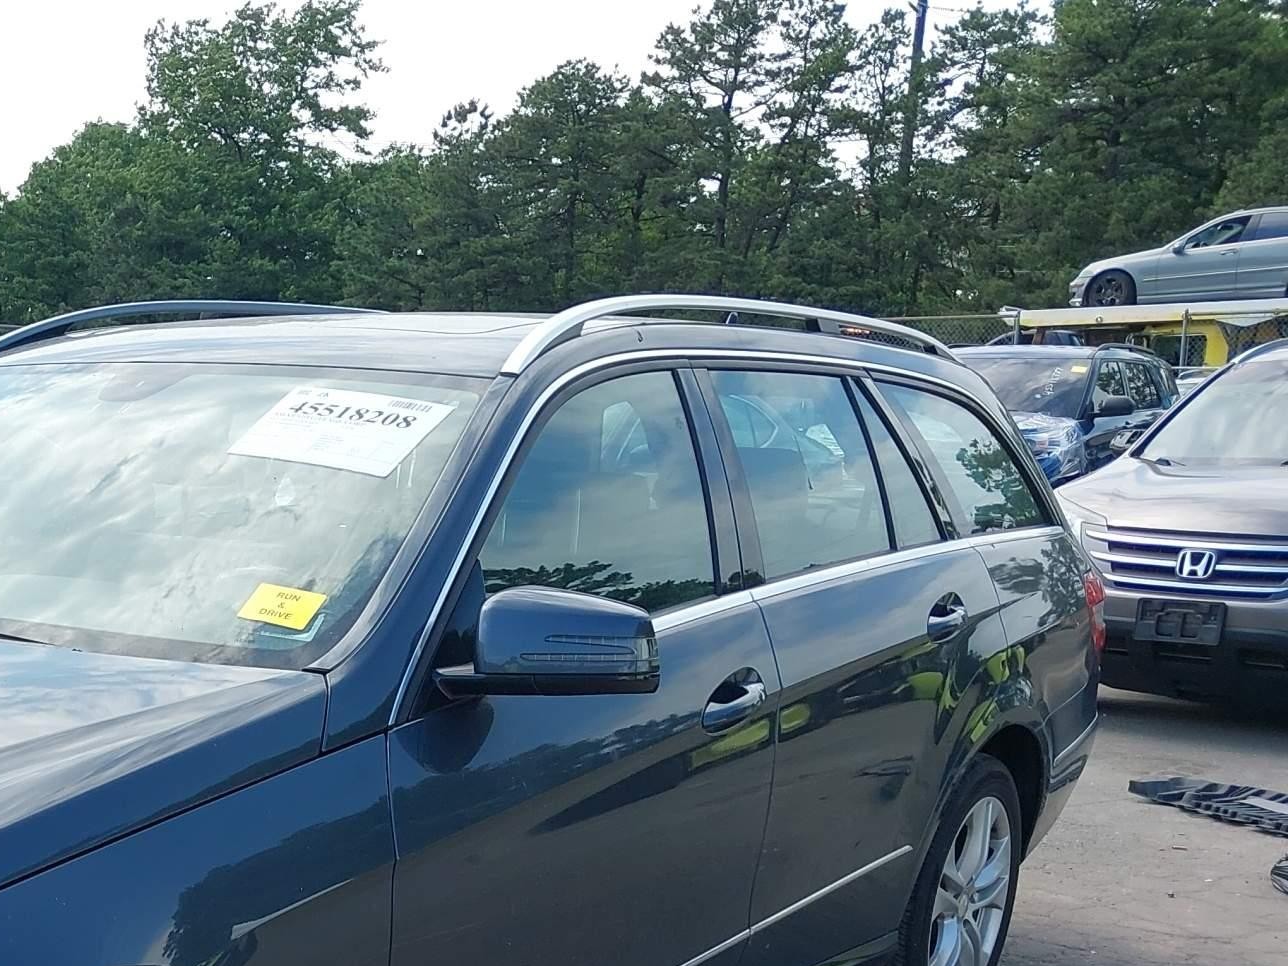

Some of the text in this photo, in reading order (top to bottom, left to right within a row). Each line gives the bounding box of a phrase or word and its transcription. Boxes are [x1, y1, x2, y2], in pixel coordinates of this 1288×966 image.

[288, 401, 418, 429] 45518208
[276, 591, 302, 602] RUN
[258, 607, 294, 620] DRIVE
